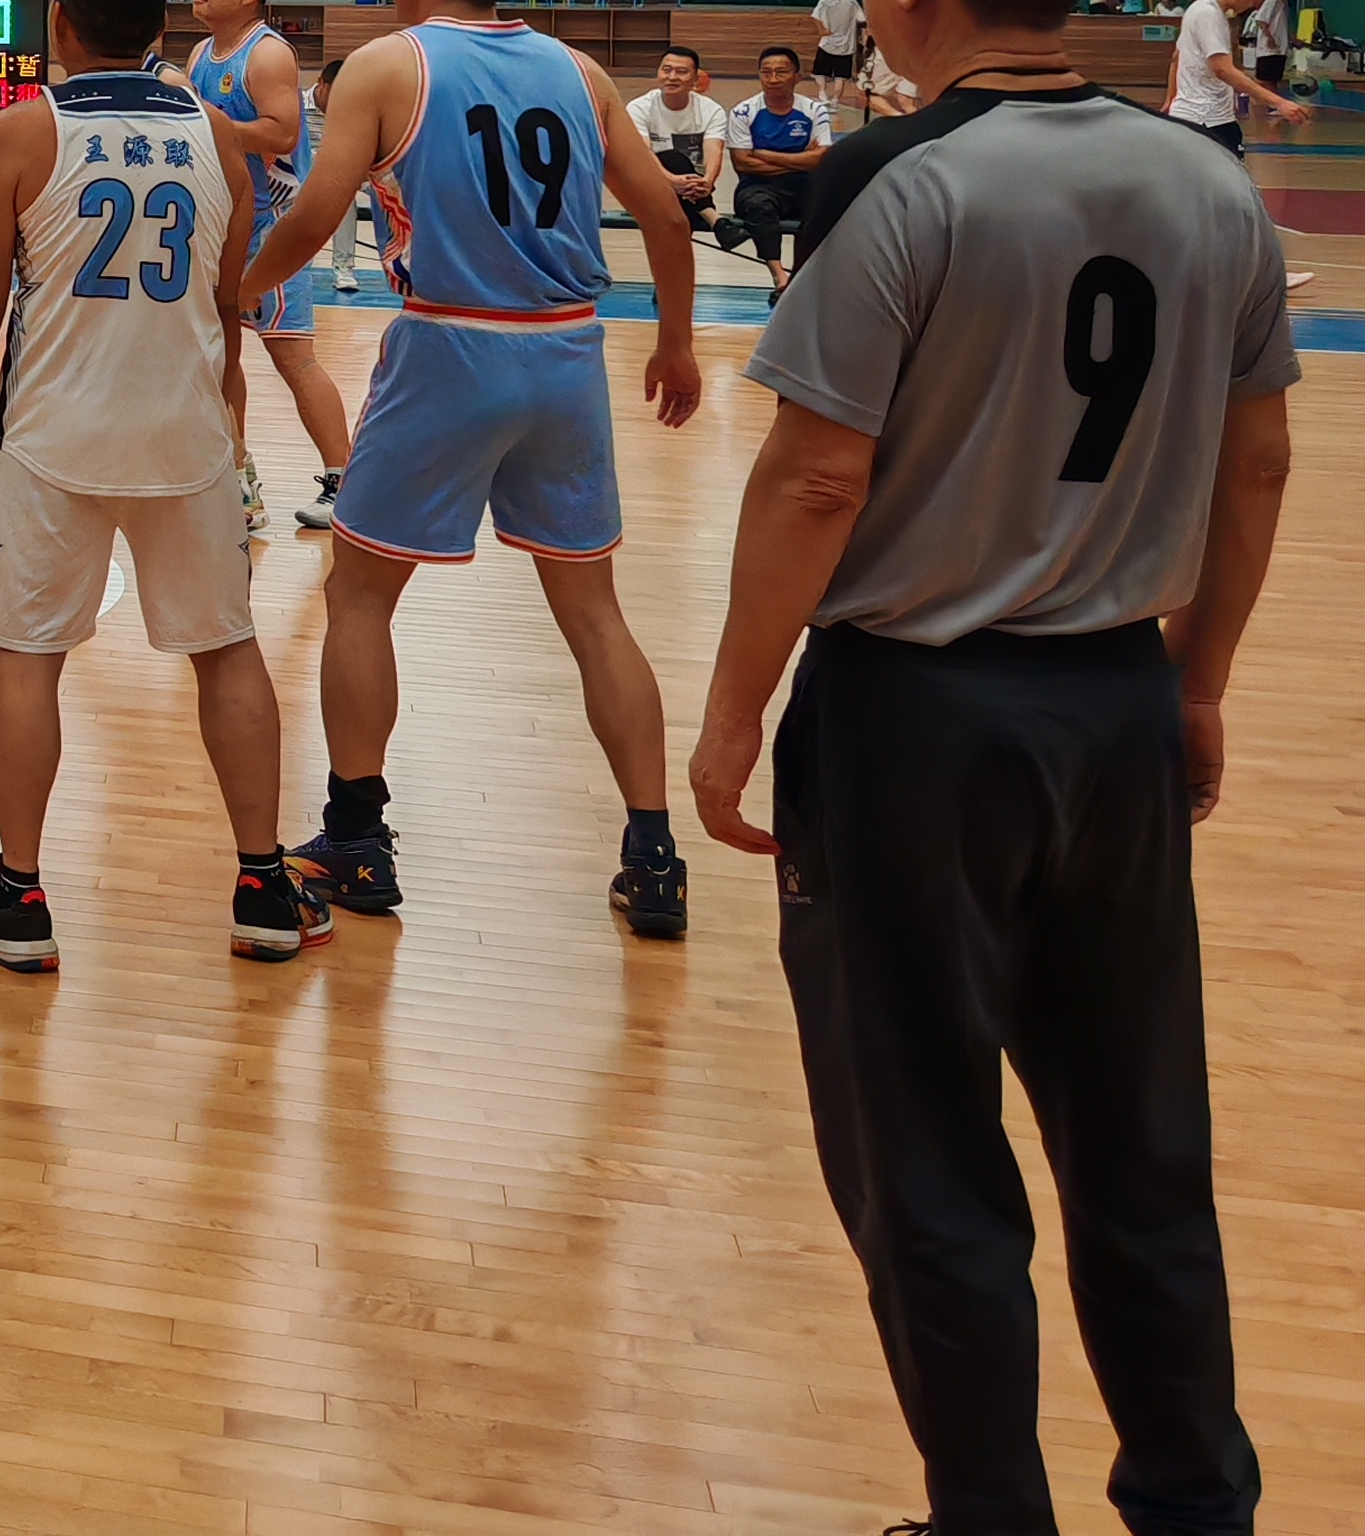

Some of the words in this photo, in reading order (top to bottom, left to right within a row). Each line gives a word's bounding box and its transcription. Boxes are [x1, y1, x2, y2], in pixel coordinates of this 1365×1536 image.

[464, 104, 571, 230] 19
[72, 177, 197, 304] 23
[1058, 254, 1157, 482] 9
